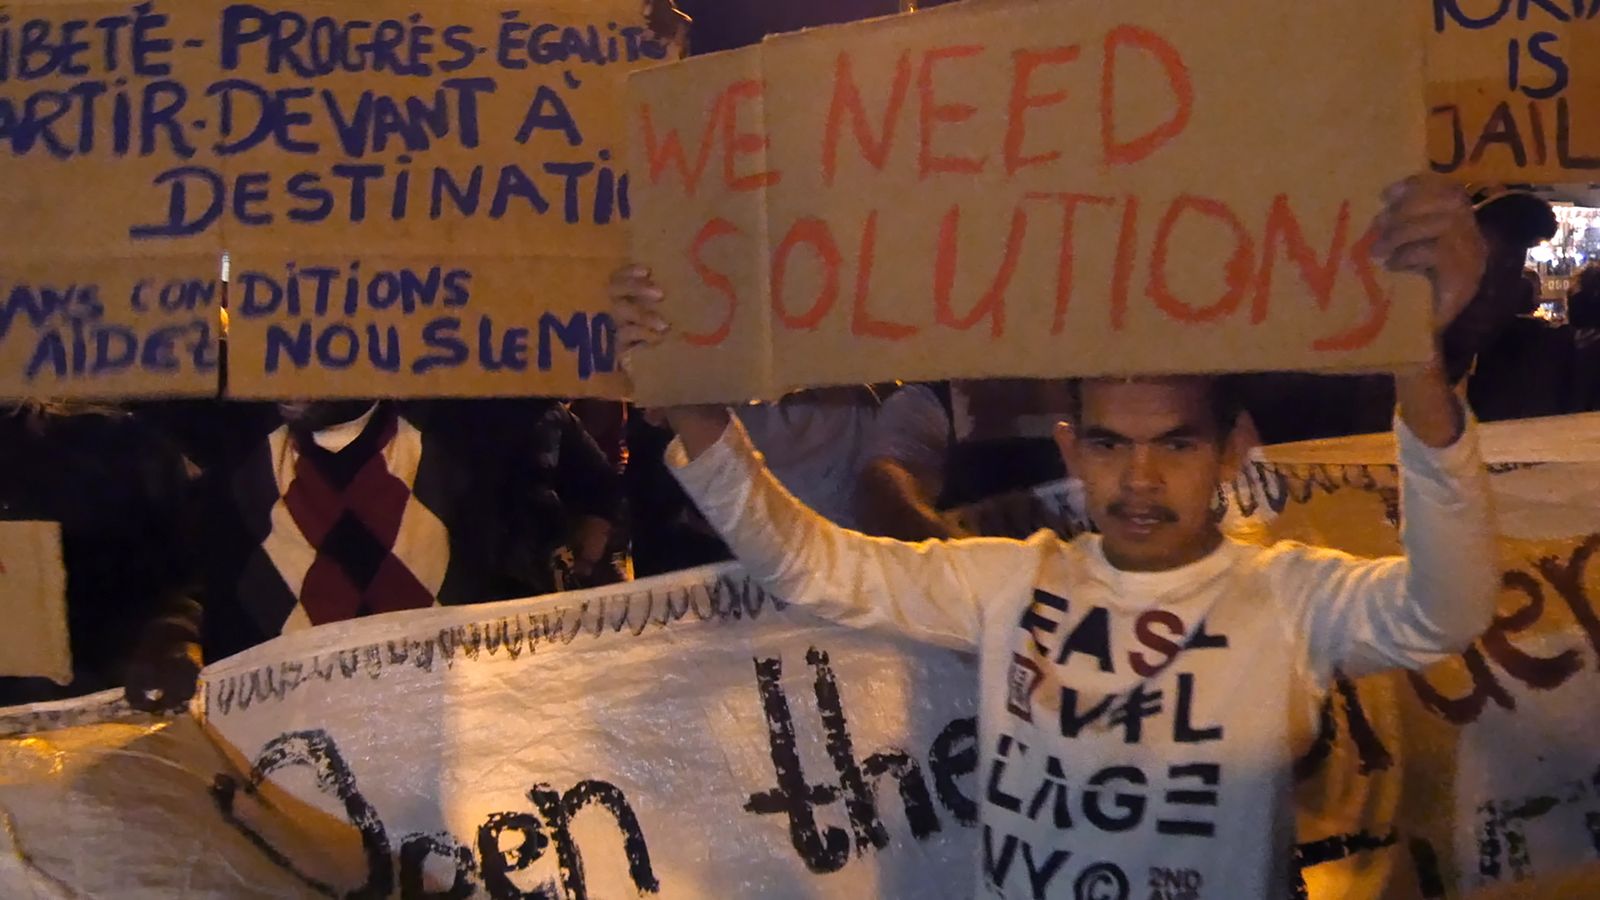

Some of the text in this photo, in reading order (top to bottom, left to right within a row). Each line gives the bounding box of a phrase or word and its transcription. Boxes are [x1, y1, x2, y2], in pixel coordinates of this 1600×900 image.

[641, 25, 1194, 196] WE NEED
[1430, 97, 1600, 173] JAIL
[1508, 31, 1569, 99] IS
[681, 193, 1392, 351] SOLUTIONS
[743, 646, 977, 875] the
